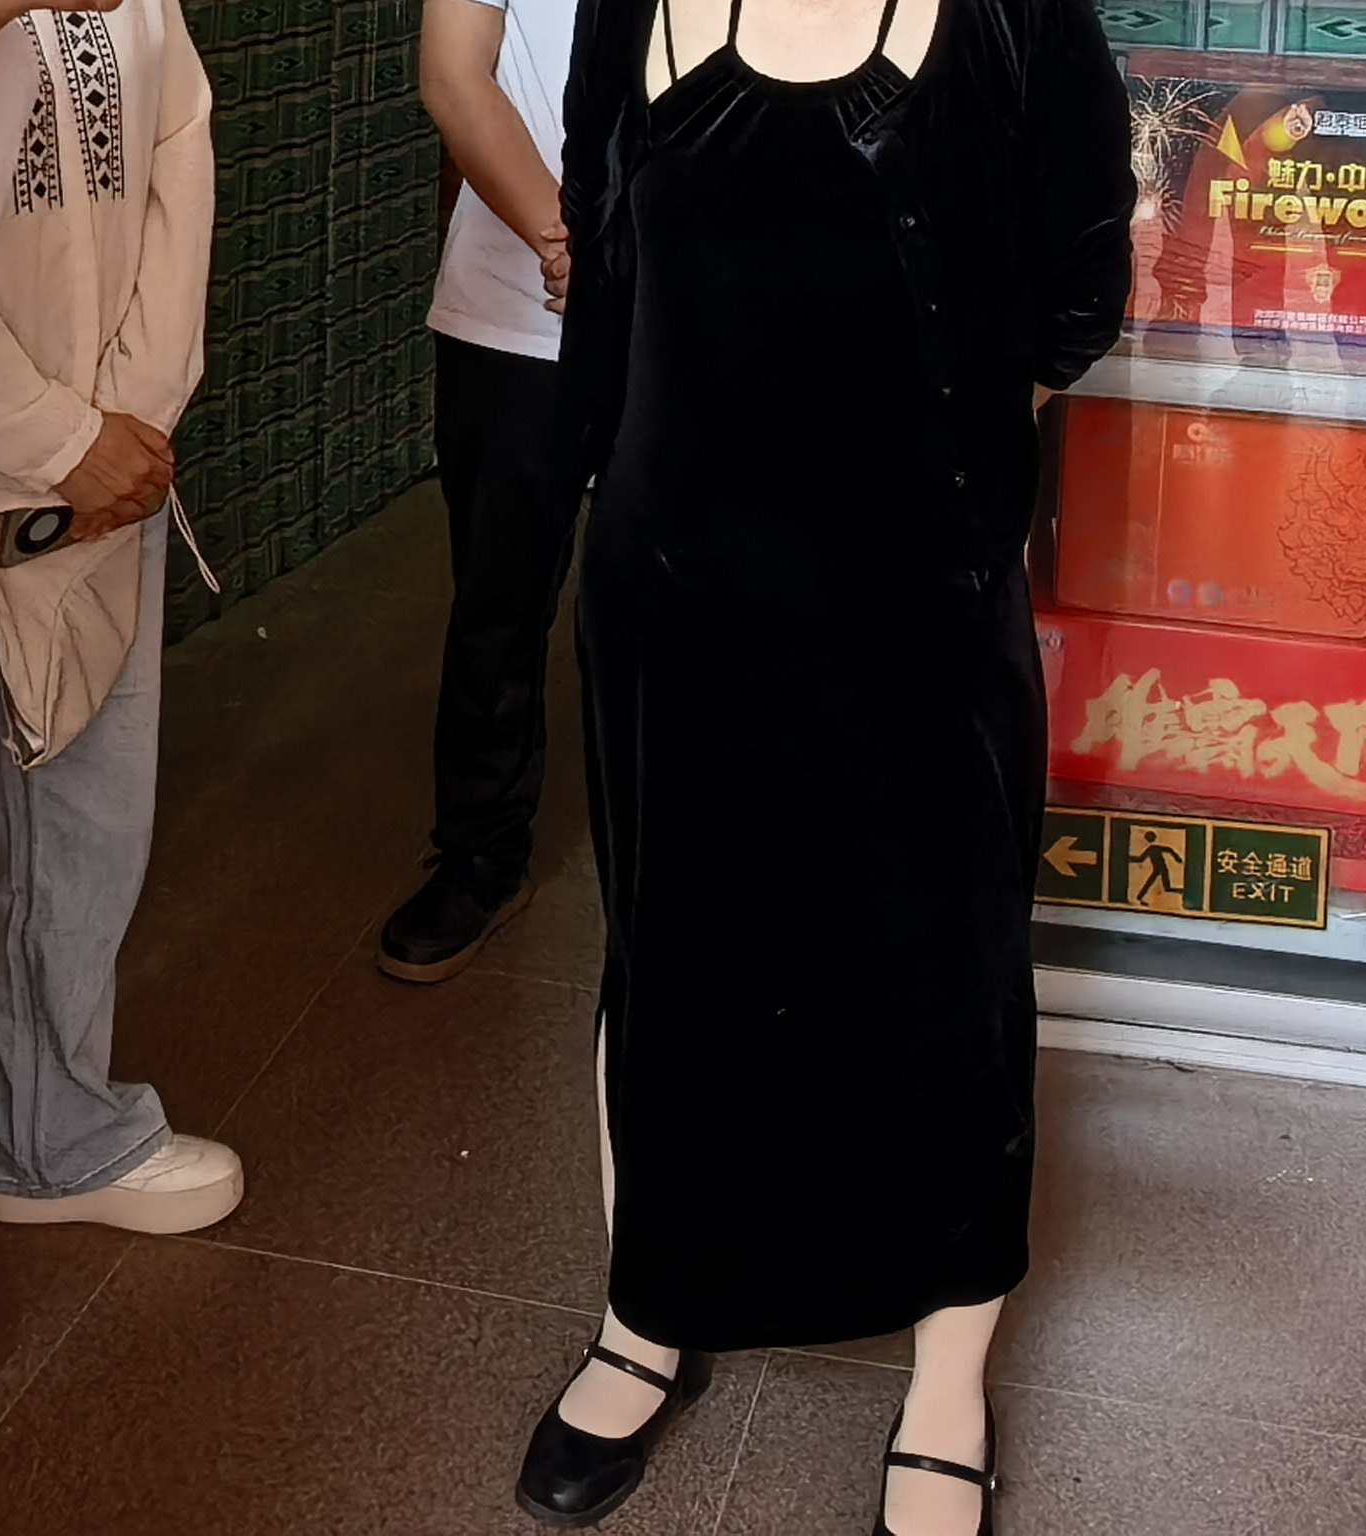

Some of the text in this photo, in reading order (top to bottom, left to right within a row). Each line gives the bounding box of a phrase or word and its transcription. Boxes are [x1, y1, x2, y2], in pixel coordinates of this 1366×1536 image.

[1216, 847, 1314, 882] 安全通道
[1232, 881, 1296, 905] EXIT
